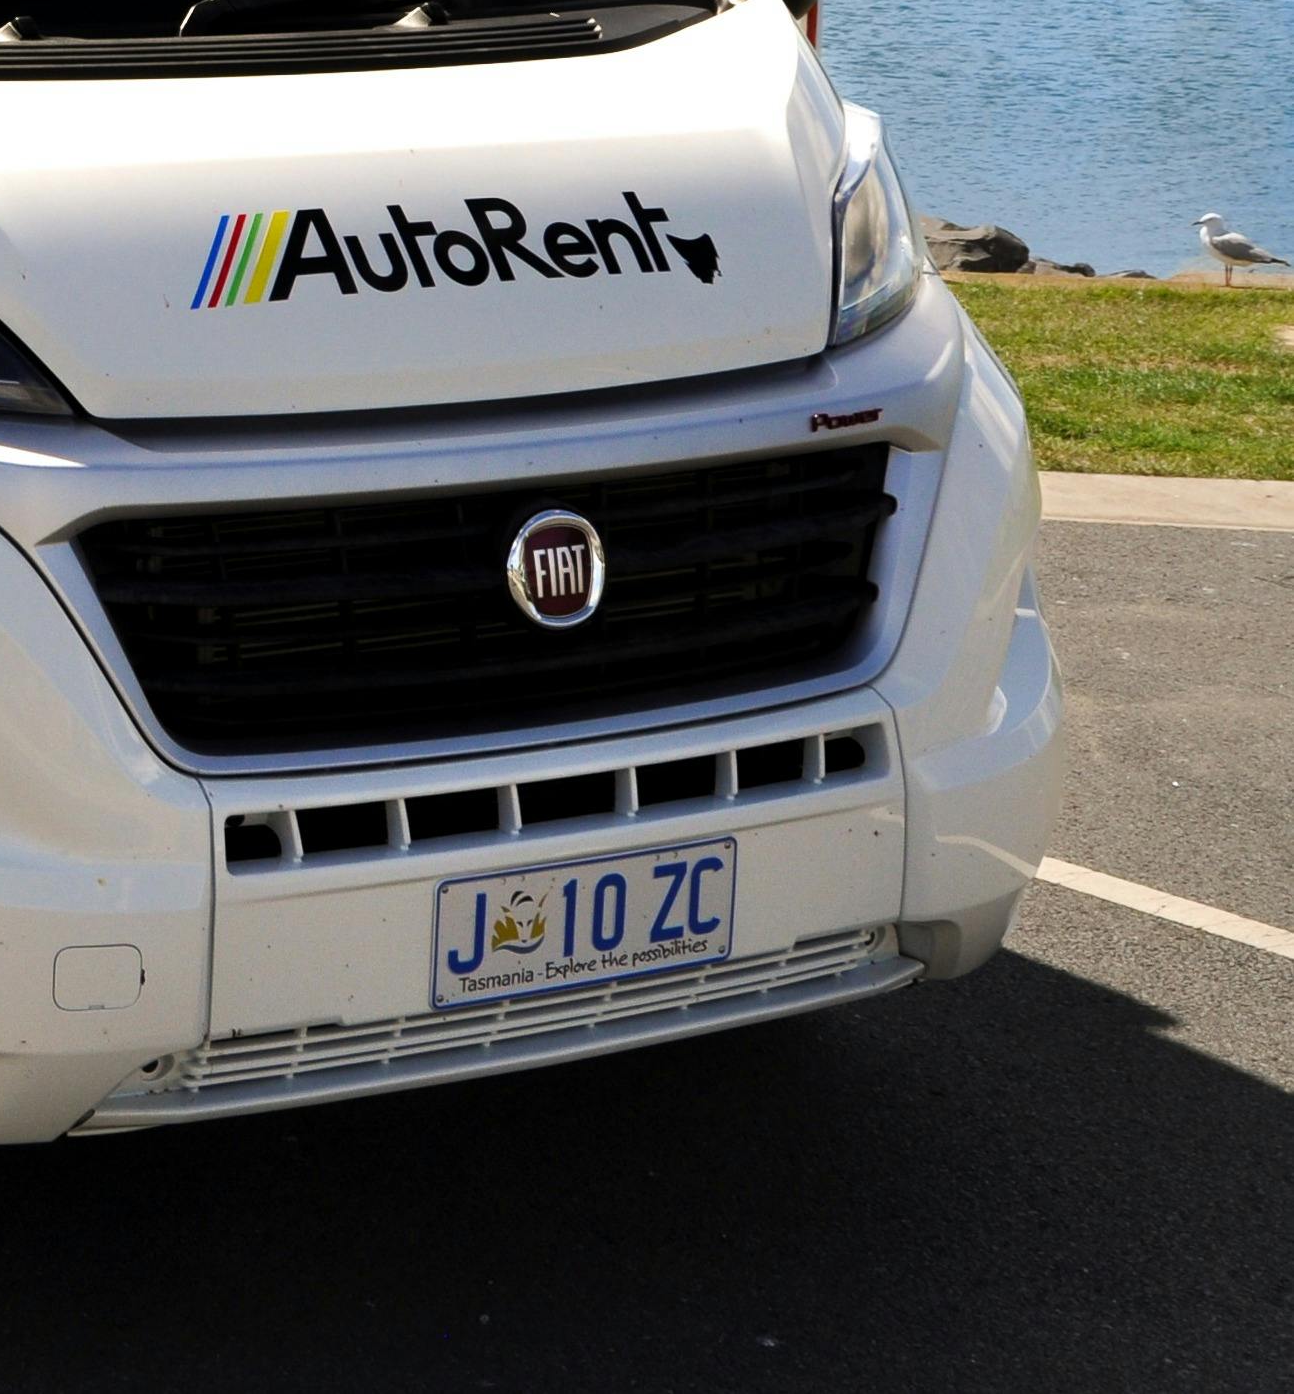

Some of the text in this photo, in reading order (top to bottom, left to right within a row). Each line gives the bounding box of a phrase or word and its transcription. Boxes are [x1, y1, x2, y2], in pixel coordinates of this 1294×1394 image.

[267, 191, 670, 302] AutoRent
[811, 409, 883, 432] Power
[532, 543, 586, 599] FIAT
[448, 857, 724, 975] J 10 ZC
[459, 970, 534, 994] Tasmania
[545, 961, 597, 983] Explore
[601, 951, 627, 969] the
[632, 938, 708, 966] possibilities
